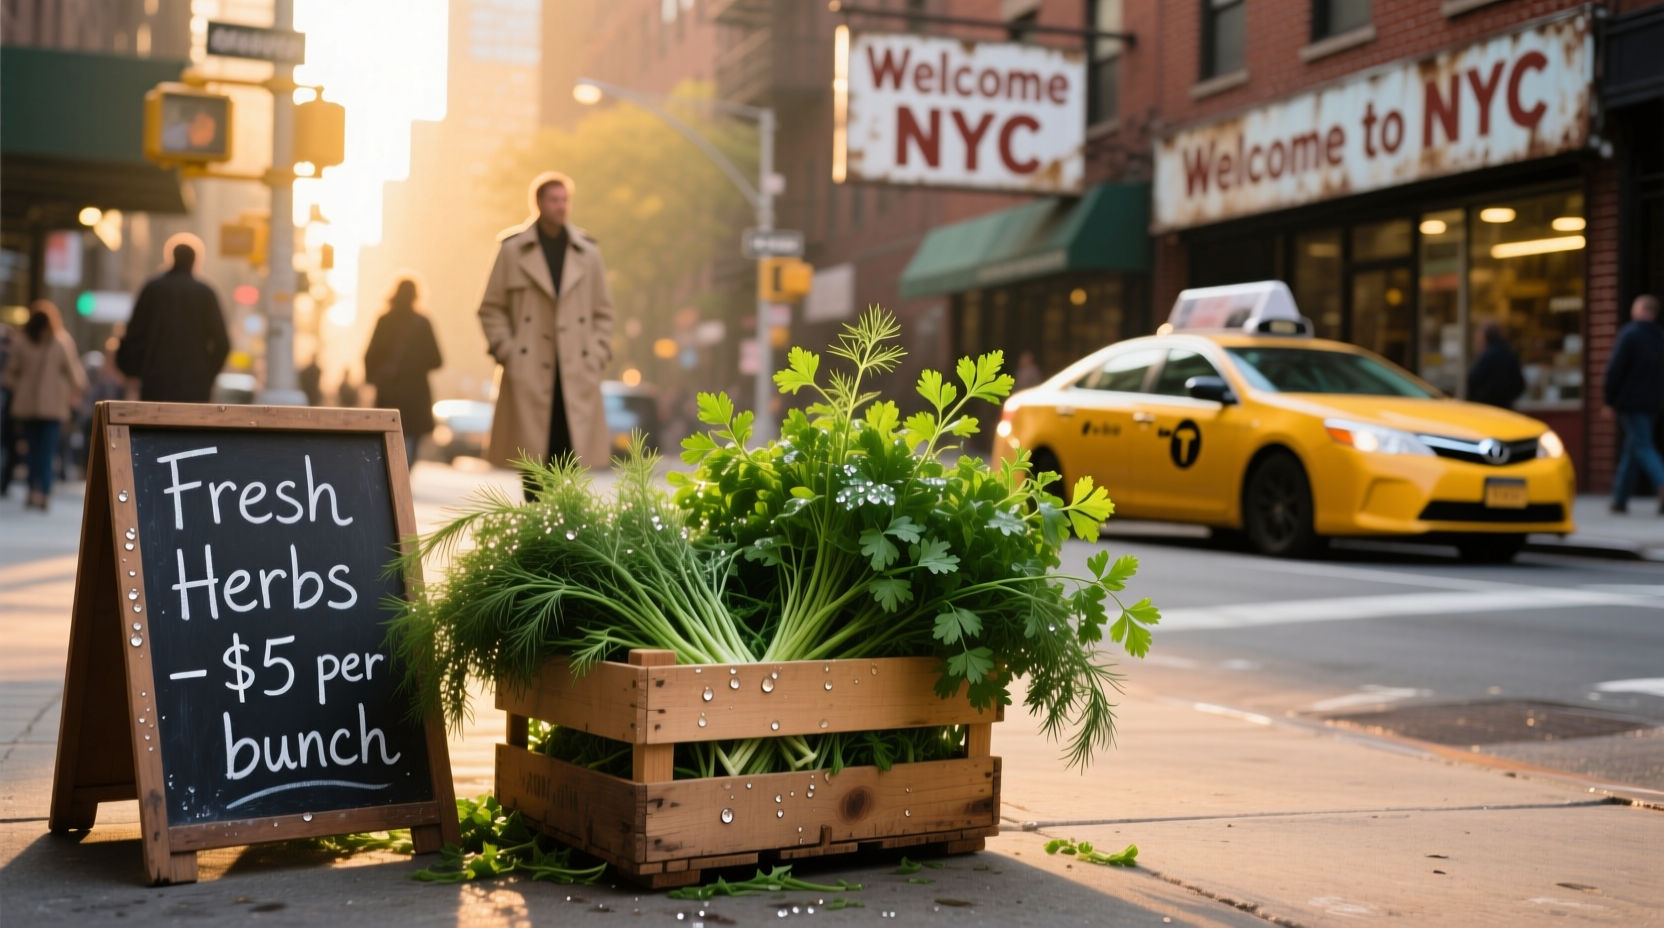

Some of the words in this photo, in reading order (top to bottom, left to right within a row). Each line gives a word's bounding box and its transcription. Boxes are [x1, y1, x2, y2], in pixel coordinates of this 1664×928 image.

[867, 46, 1069, 104] Welcome
[896, 106, 1041, 174] NYC
[1184, 125, 1345, 197] Welcome
[1362, 101, 1404, 159] to
[1424, 50, 1548, 148] NYC
[156, 446, 353, 530] Fresh
[172, 543, 358, 620] Herbs
[222, 632, 295, 703] $5
[317, 652, 385, 705] per
[223, 702, 401, 780] bunch
